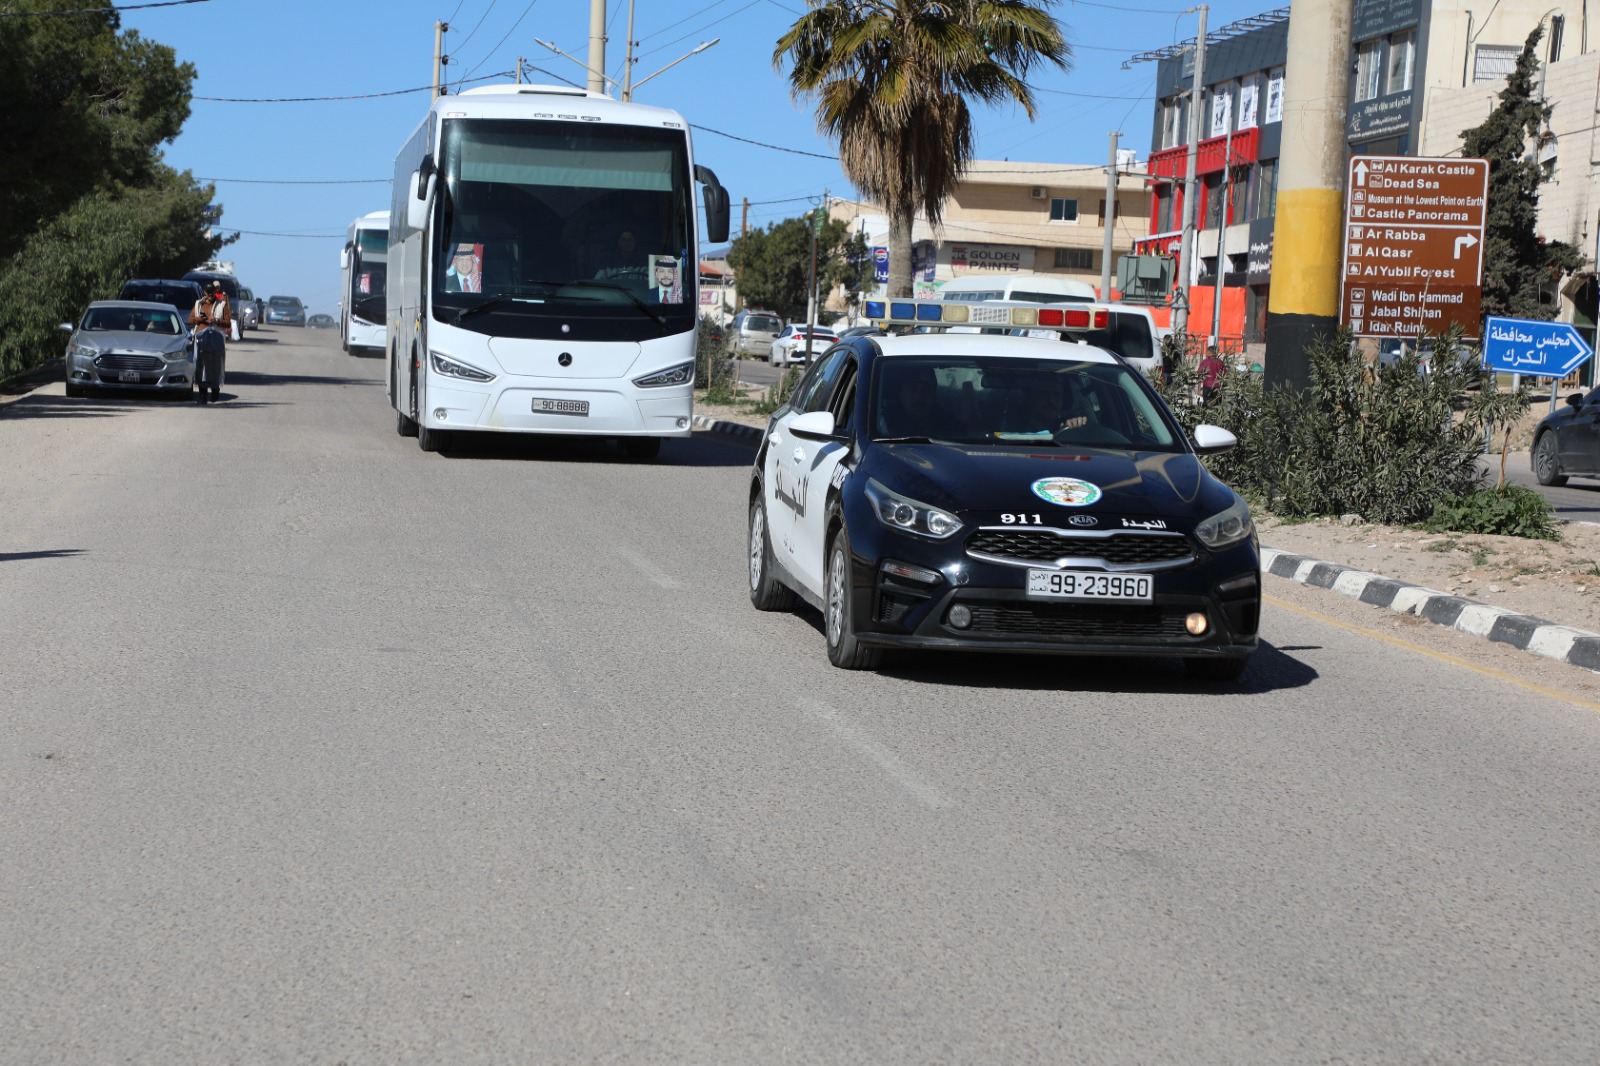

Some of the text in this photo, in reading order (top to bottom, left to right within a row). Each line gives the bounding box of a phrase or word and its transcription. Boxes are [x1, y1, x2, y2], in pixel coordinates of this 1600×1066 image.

[1384, 163, 1476, 175] Al Karak Castle
[1384, 178, 1440, 189] Dead Sea
[1368, 194, 1484, 206] Museum at the Lowest Point on Earth
[1368, 208, 1468, 220] Castle Panorama
[1366, 228, 1426, 240] Ar Rabba
[970, 250, 1020, 260] GOLDEN
[1365, 247, 1412, 258] Al Qasr
[970, 261, 1019, 272] PAINTS
[1364, 266, 1454, 278] Al Yubil Forest
[1372, 290, 1463, 304] Wadi Ibn Hammad
[1370, 306, 1400, 317] Jabal
[1370, 320, 1392, 332] Idar
[1536, 332, 1570, 349] مجلس
[1502, 348, 1546, 366] الكرك
[1000, 514, 1042, 524] 911
[1073, 516, 1093, 524] KIA
[1122, 518, 1166, 530] النجدة
